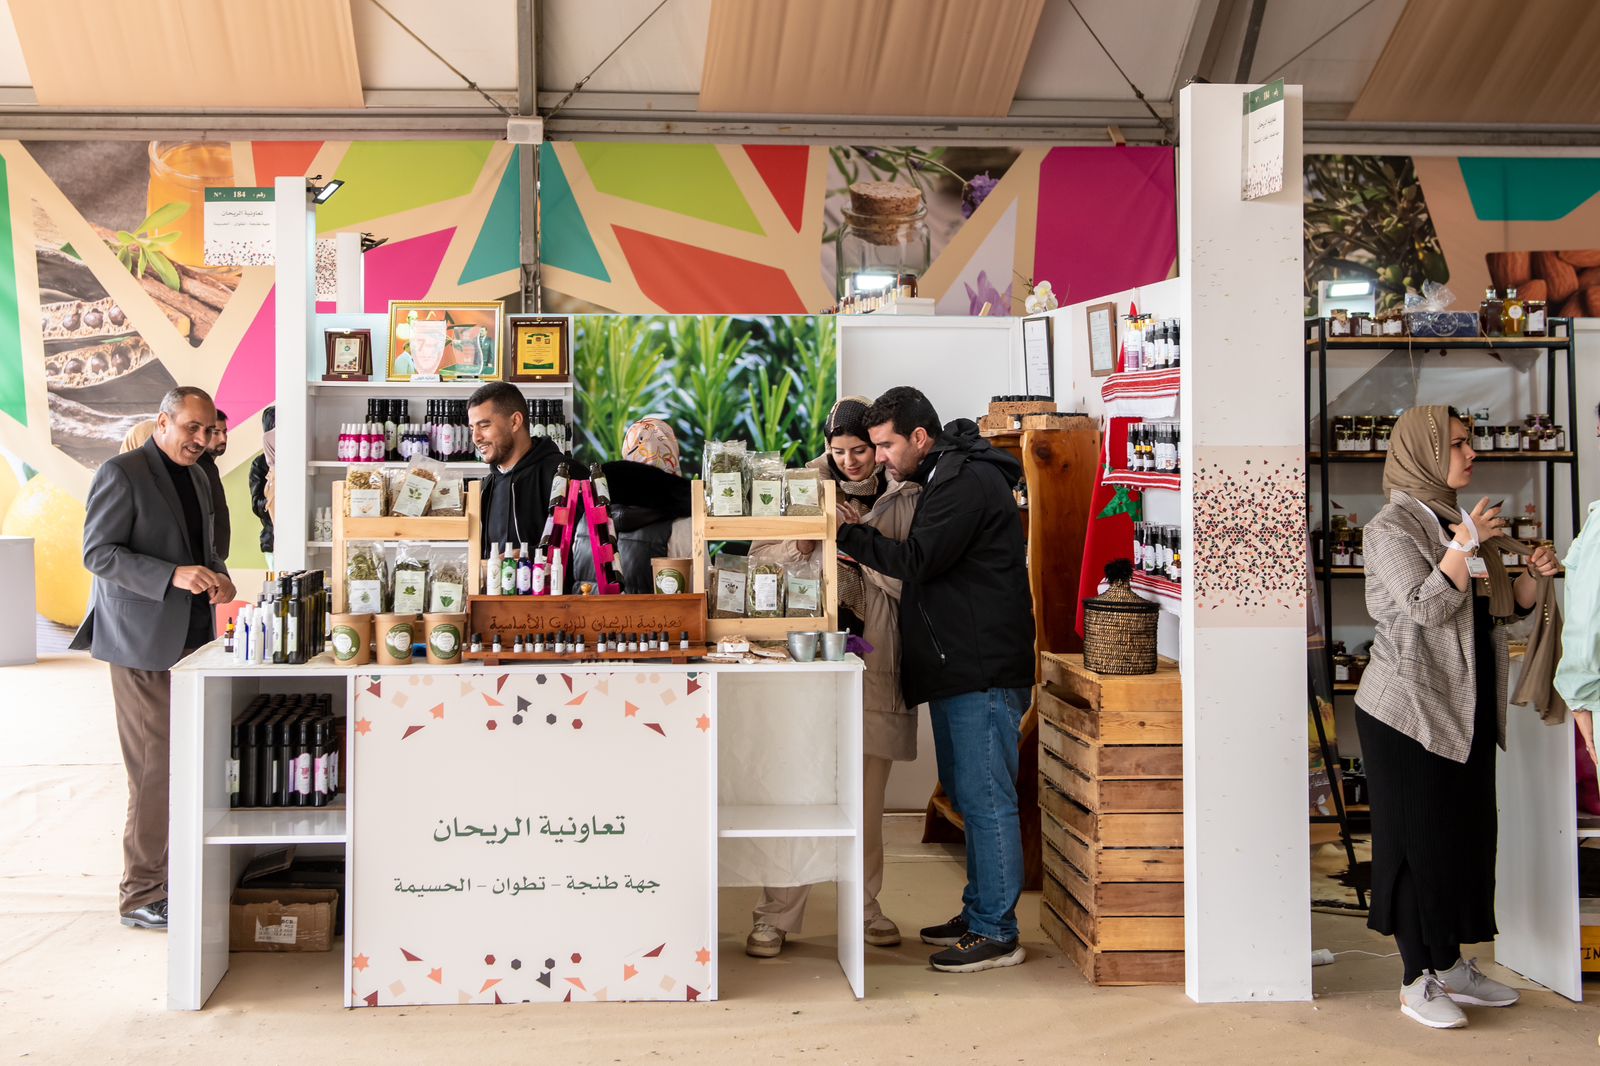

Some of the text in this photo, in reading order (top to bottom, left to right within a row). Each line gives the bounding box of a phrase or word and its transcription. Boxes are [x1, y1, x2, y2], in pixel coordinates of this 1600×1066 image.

[233, 190, 246, 198] 184
[636, 614, 683, 632] تعاونية
[433, 815, 626, 845] تعاونية الريحان
[393, 877, 471, 898] الحسيمة
[492, 875, 546, 897] تطوان
[566, 874, 619, 896] طنجة
[624, 874, 661, 895] جهة
